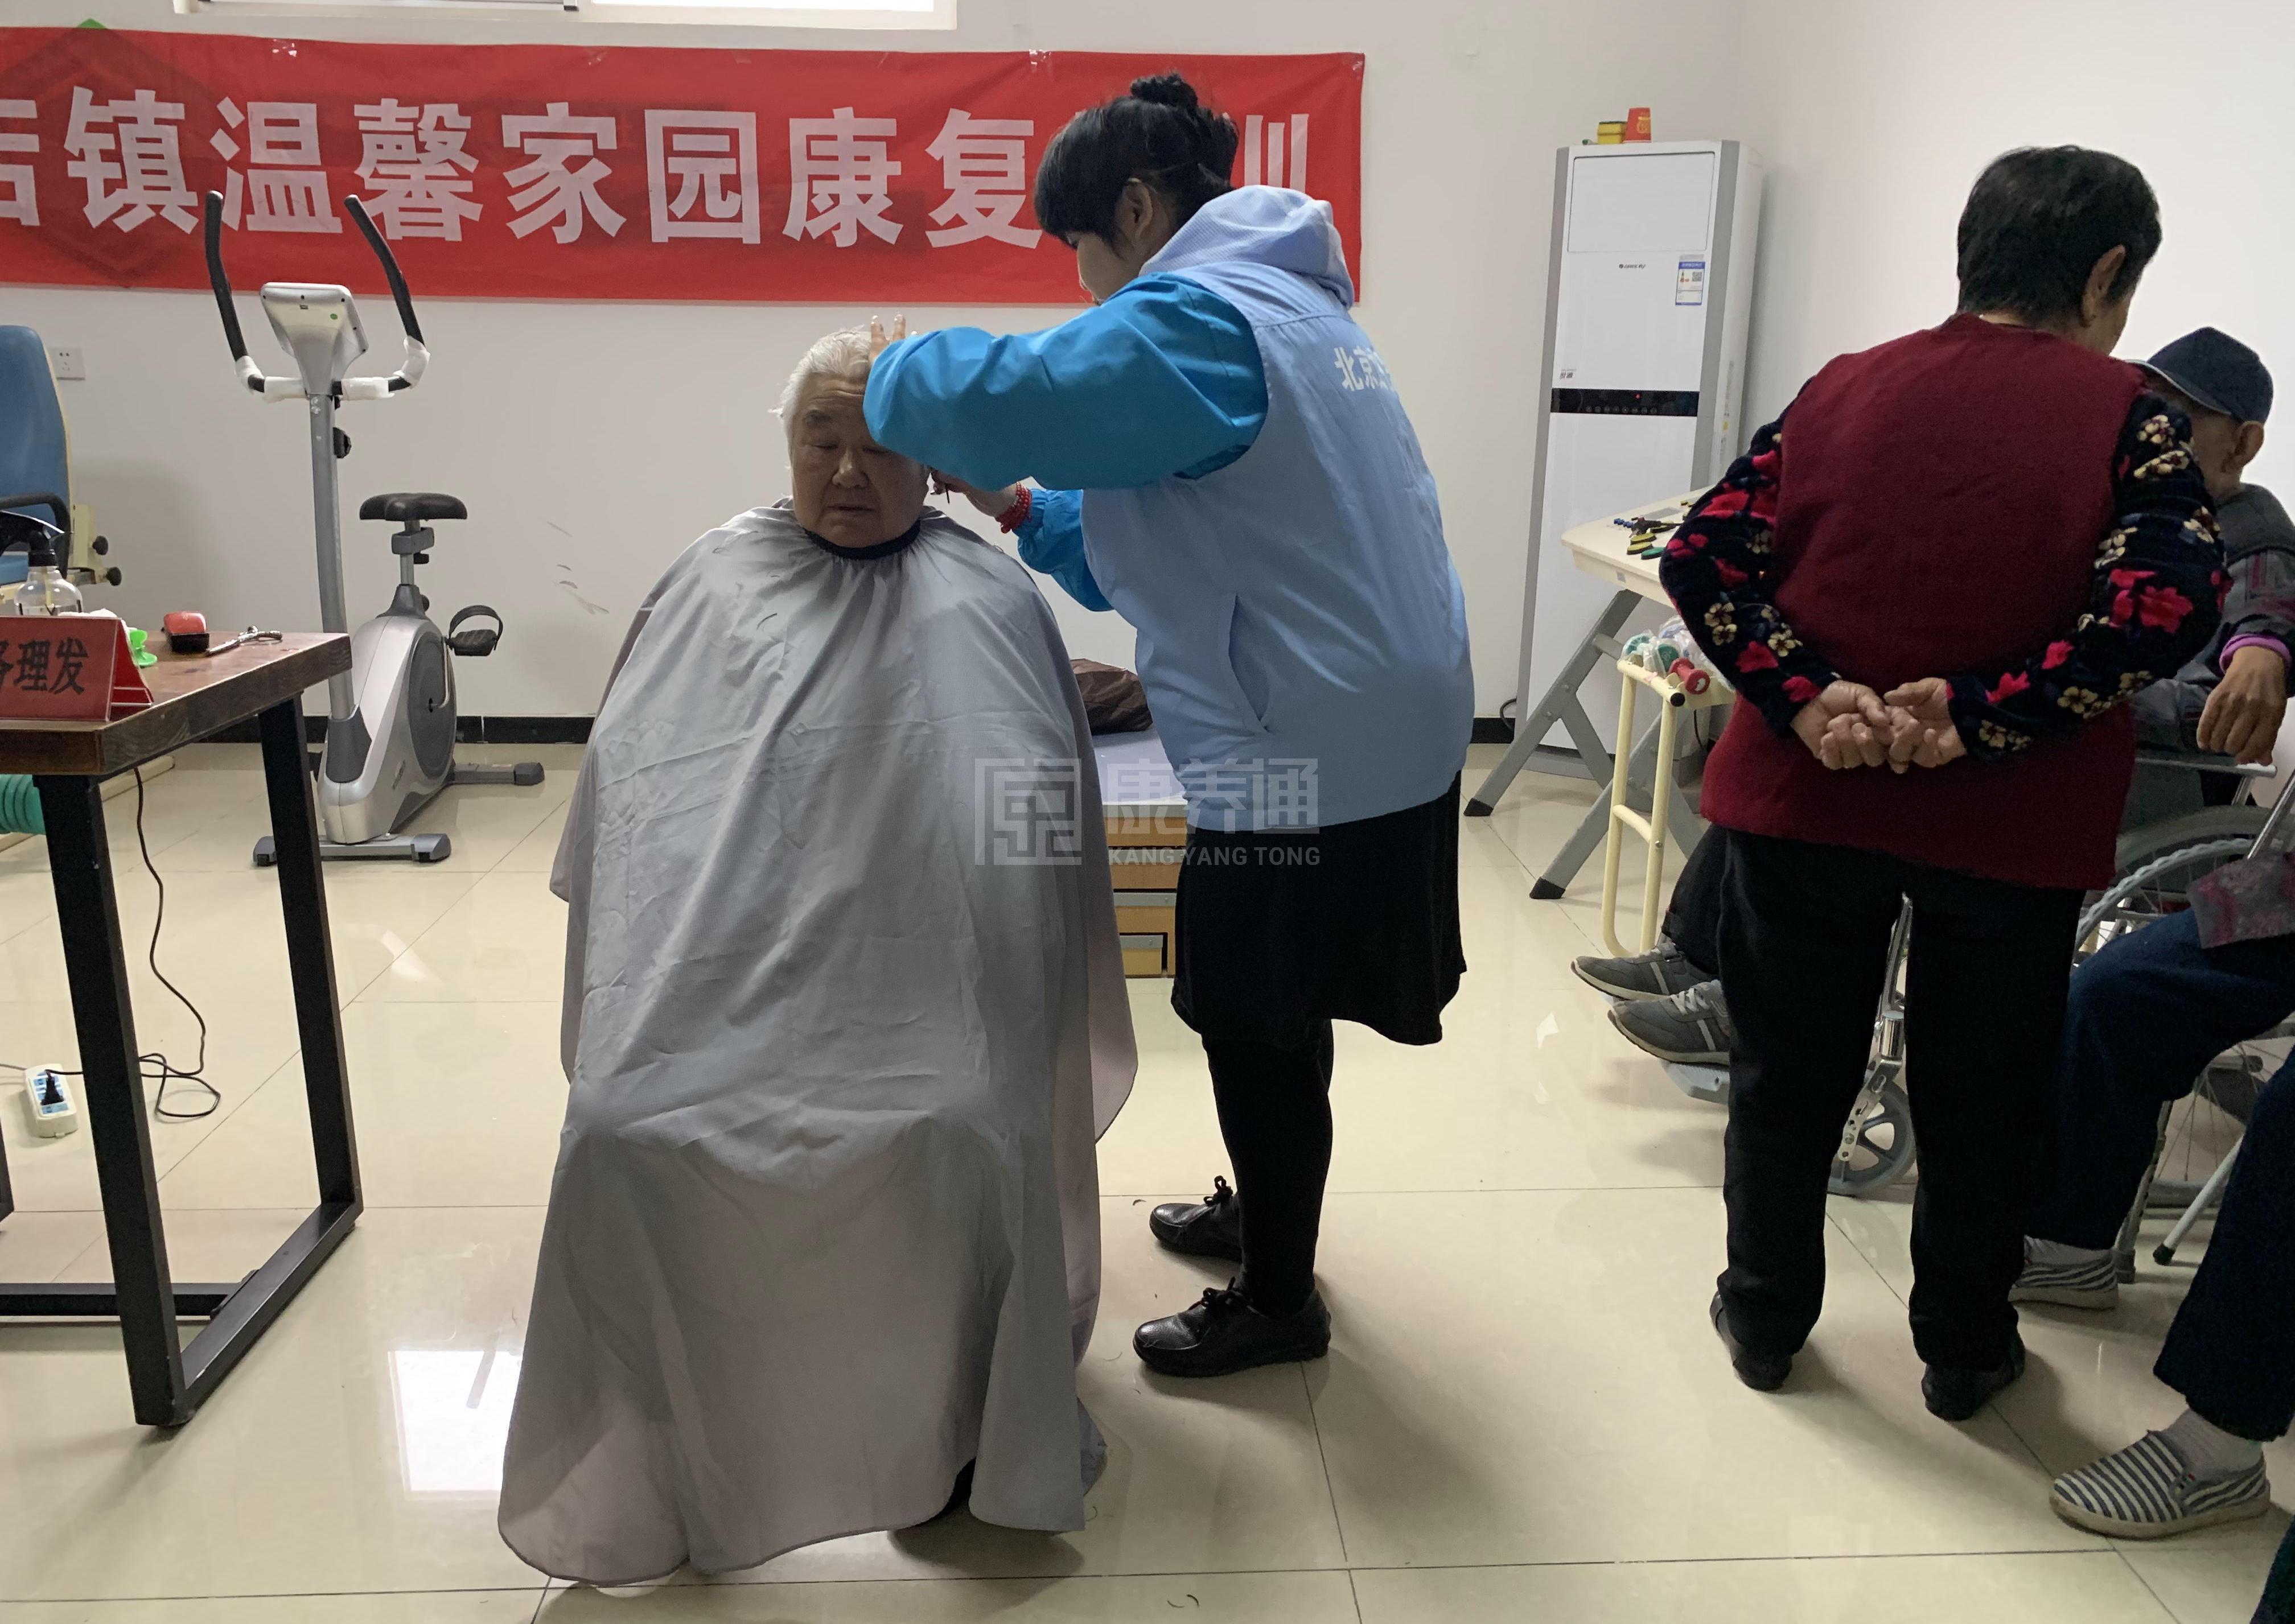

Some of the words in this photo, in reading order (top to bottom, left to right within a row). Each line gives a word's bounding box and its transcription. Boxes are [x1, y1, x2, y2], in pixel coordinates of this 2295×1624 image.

[0, 86, 1309, 249] 镇温馨家园康复
[1334, 345, 1389, 391] 北京
